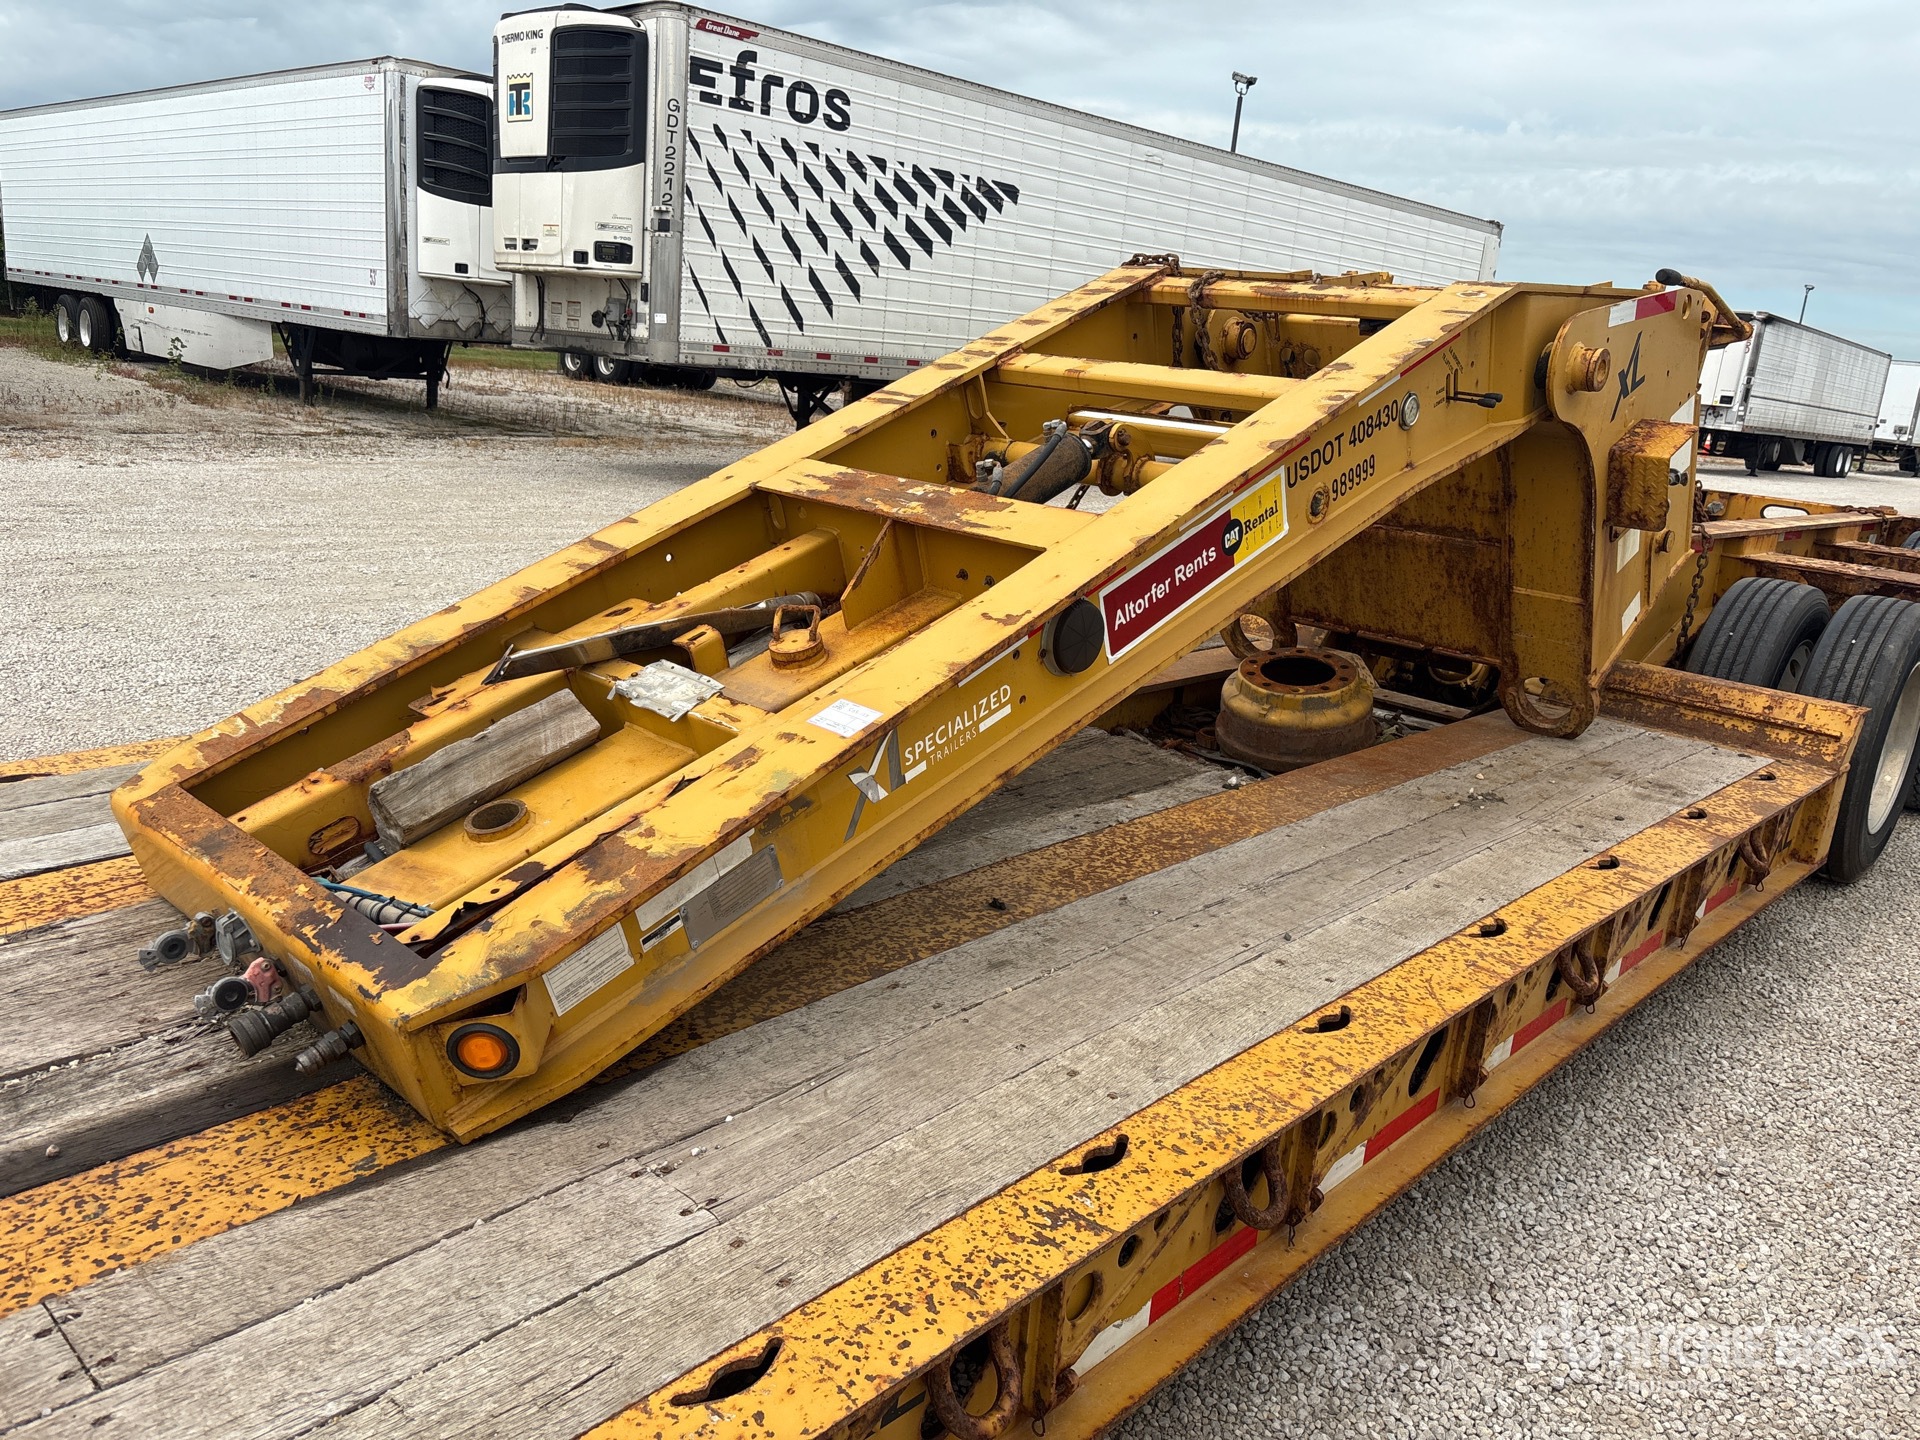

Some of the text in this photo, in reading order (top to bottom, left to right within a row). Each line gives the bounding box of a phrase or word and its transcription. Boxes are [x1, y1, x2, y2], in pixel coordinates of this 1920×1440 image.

[501, 29, 544, 45] THERMO KING
[705, 20, 741, 38] Great Dane
[689, 50, 851, 132] Efros
[661, 98, 681, 206] GDT2212
[1609, 330, 1646, 424] XL
[1286, 399, 1399, 489] USDOT 408430
[1331, 454, 1375, 502] 989999
[1224, 526, 1240, 549] CAT
[1243, 500, 1279, 535] Rental
[1114, 546, 1217, 632] Altorfer Rents
[904, 684, 1012, 766] SPECIALIZED
[929, 727, 978, 766] TRAILERS
